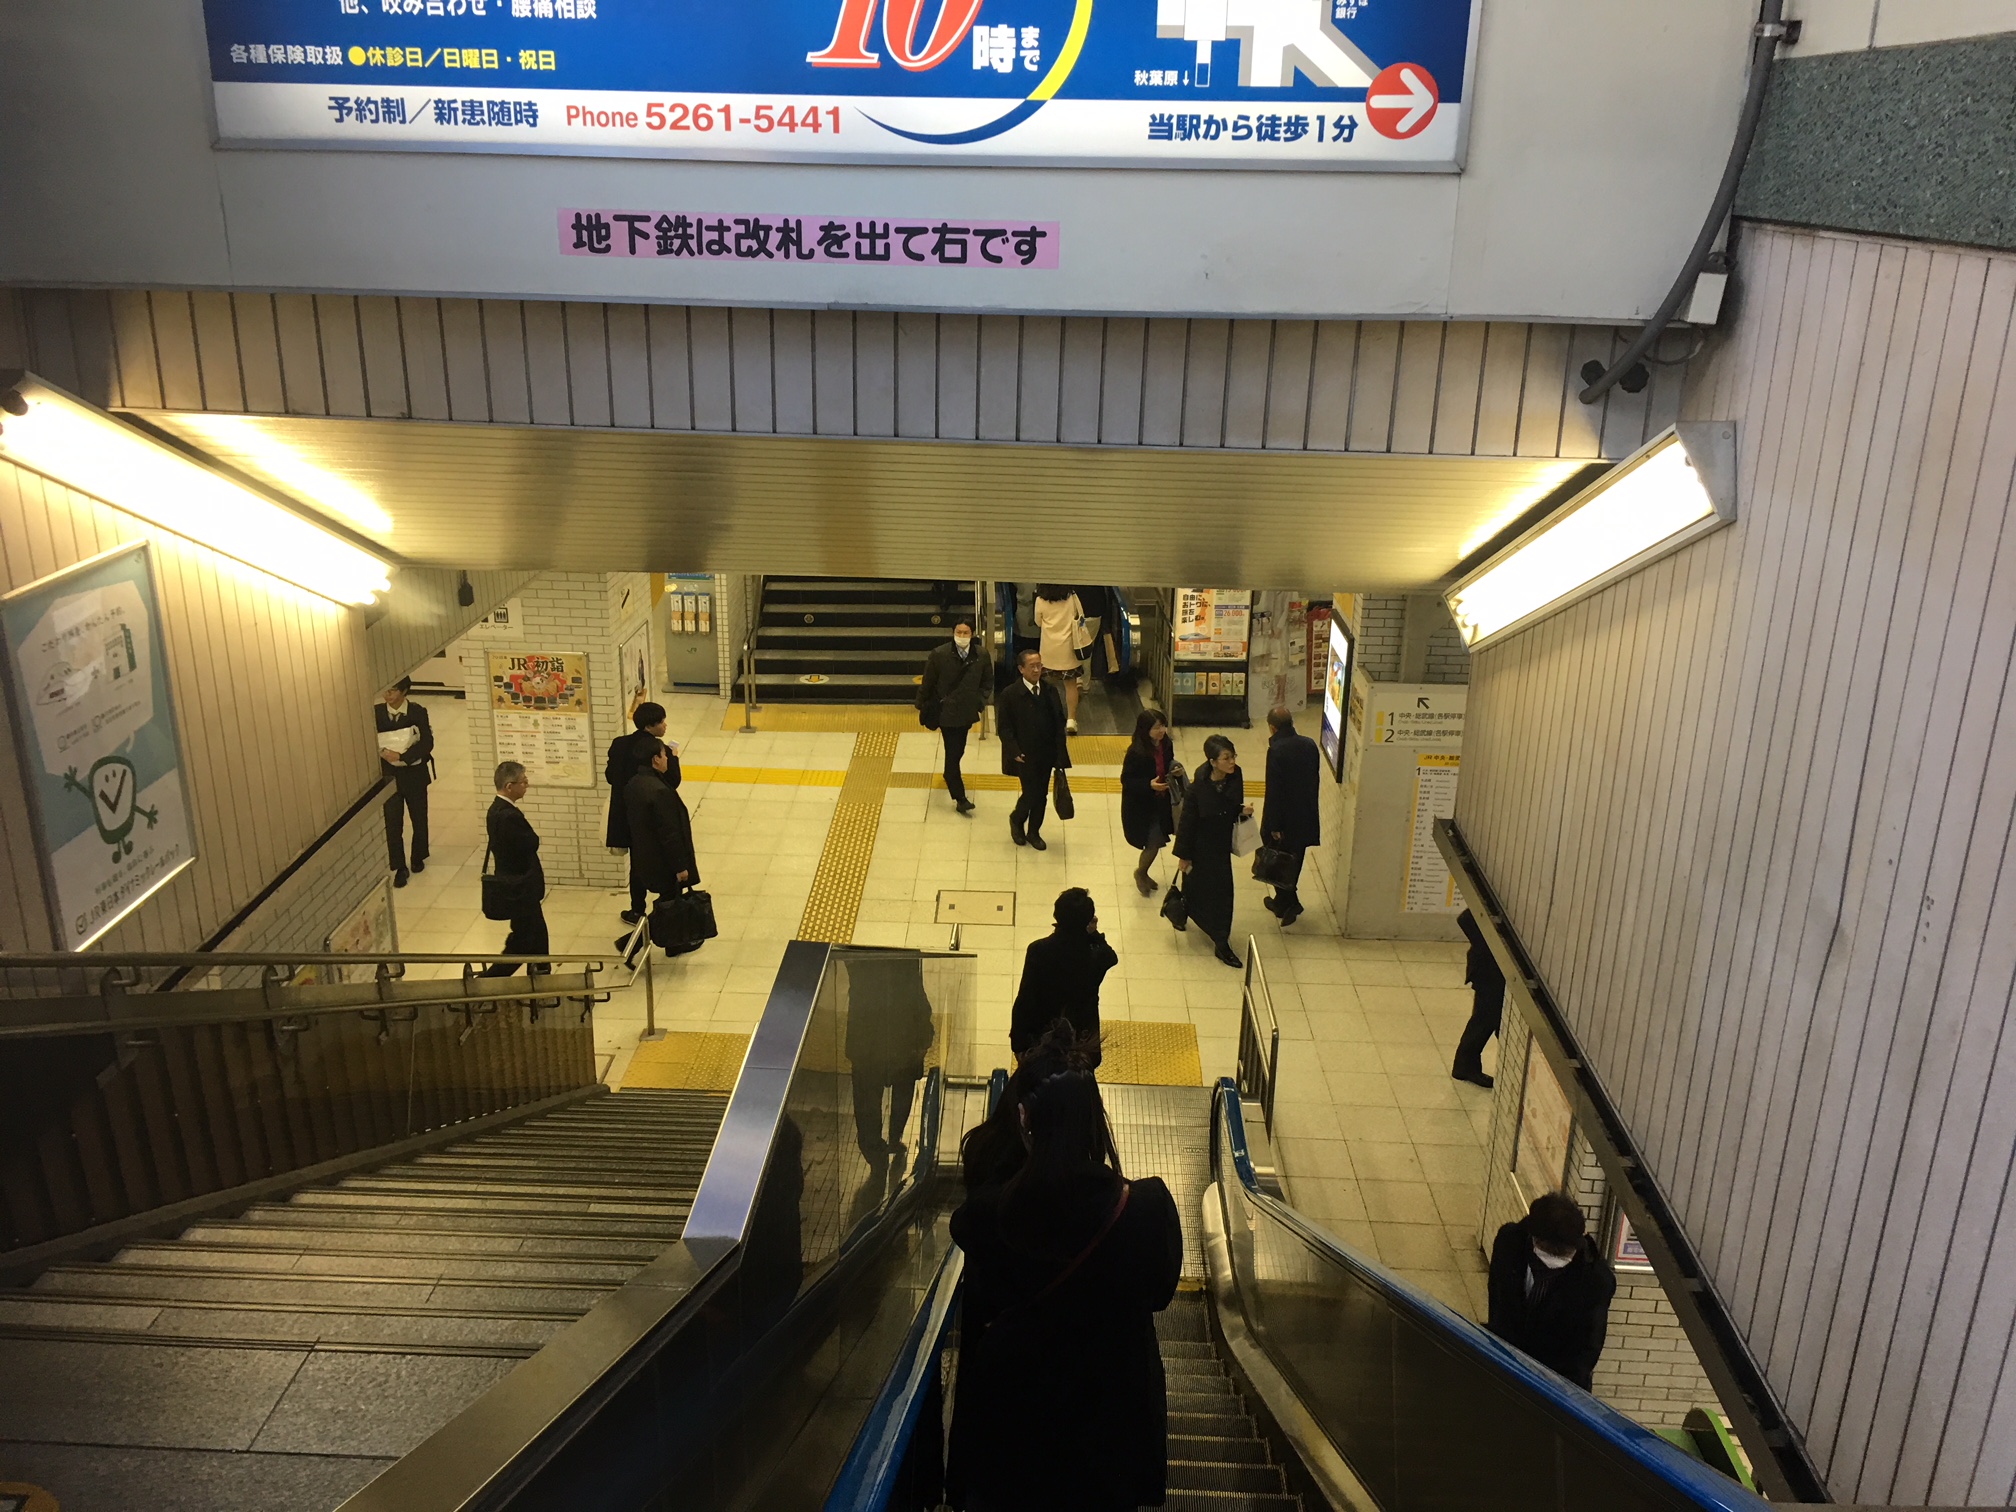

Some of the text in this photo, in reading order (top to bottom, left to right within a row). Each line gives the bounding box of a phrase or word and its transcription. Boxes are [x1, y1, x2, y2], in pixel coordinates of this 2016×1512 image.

[1335, 7, 1358, 19] 銀行
[230, 44, 343, 66] 各種保険取扱
[1134, 70, 1179, 86] 秋葉原
[566, 105, 638, 128] Phone
[645, 102, 841, 134] 5261-5441
[1148, 113, 1358, 143] 当駅から徒歩1分
[571, 212, 1047, 266] 地下鉄は改札を出て右です
[1388, 712, 1395, 726] 1
[1385, 729, 1395, 743] 2
